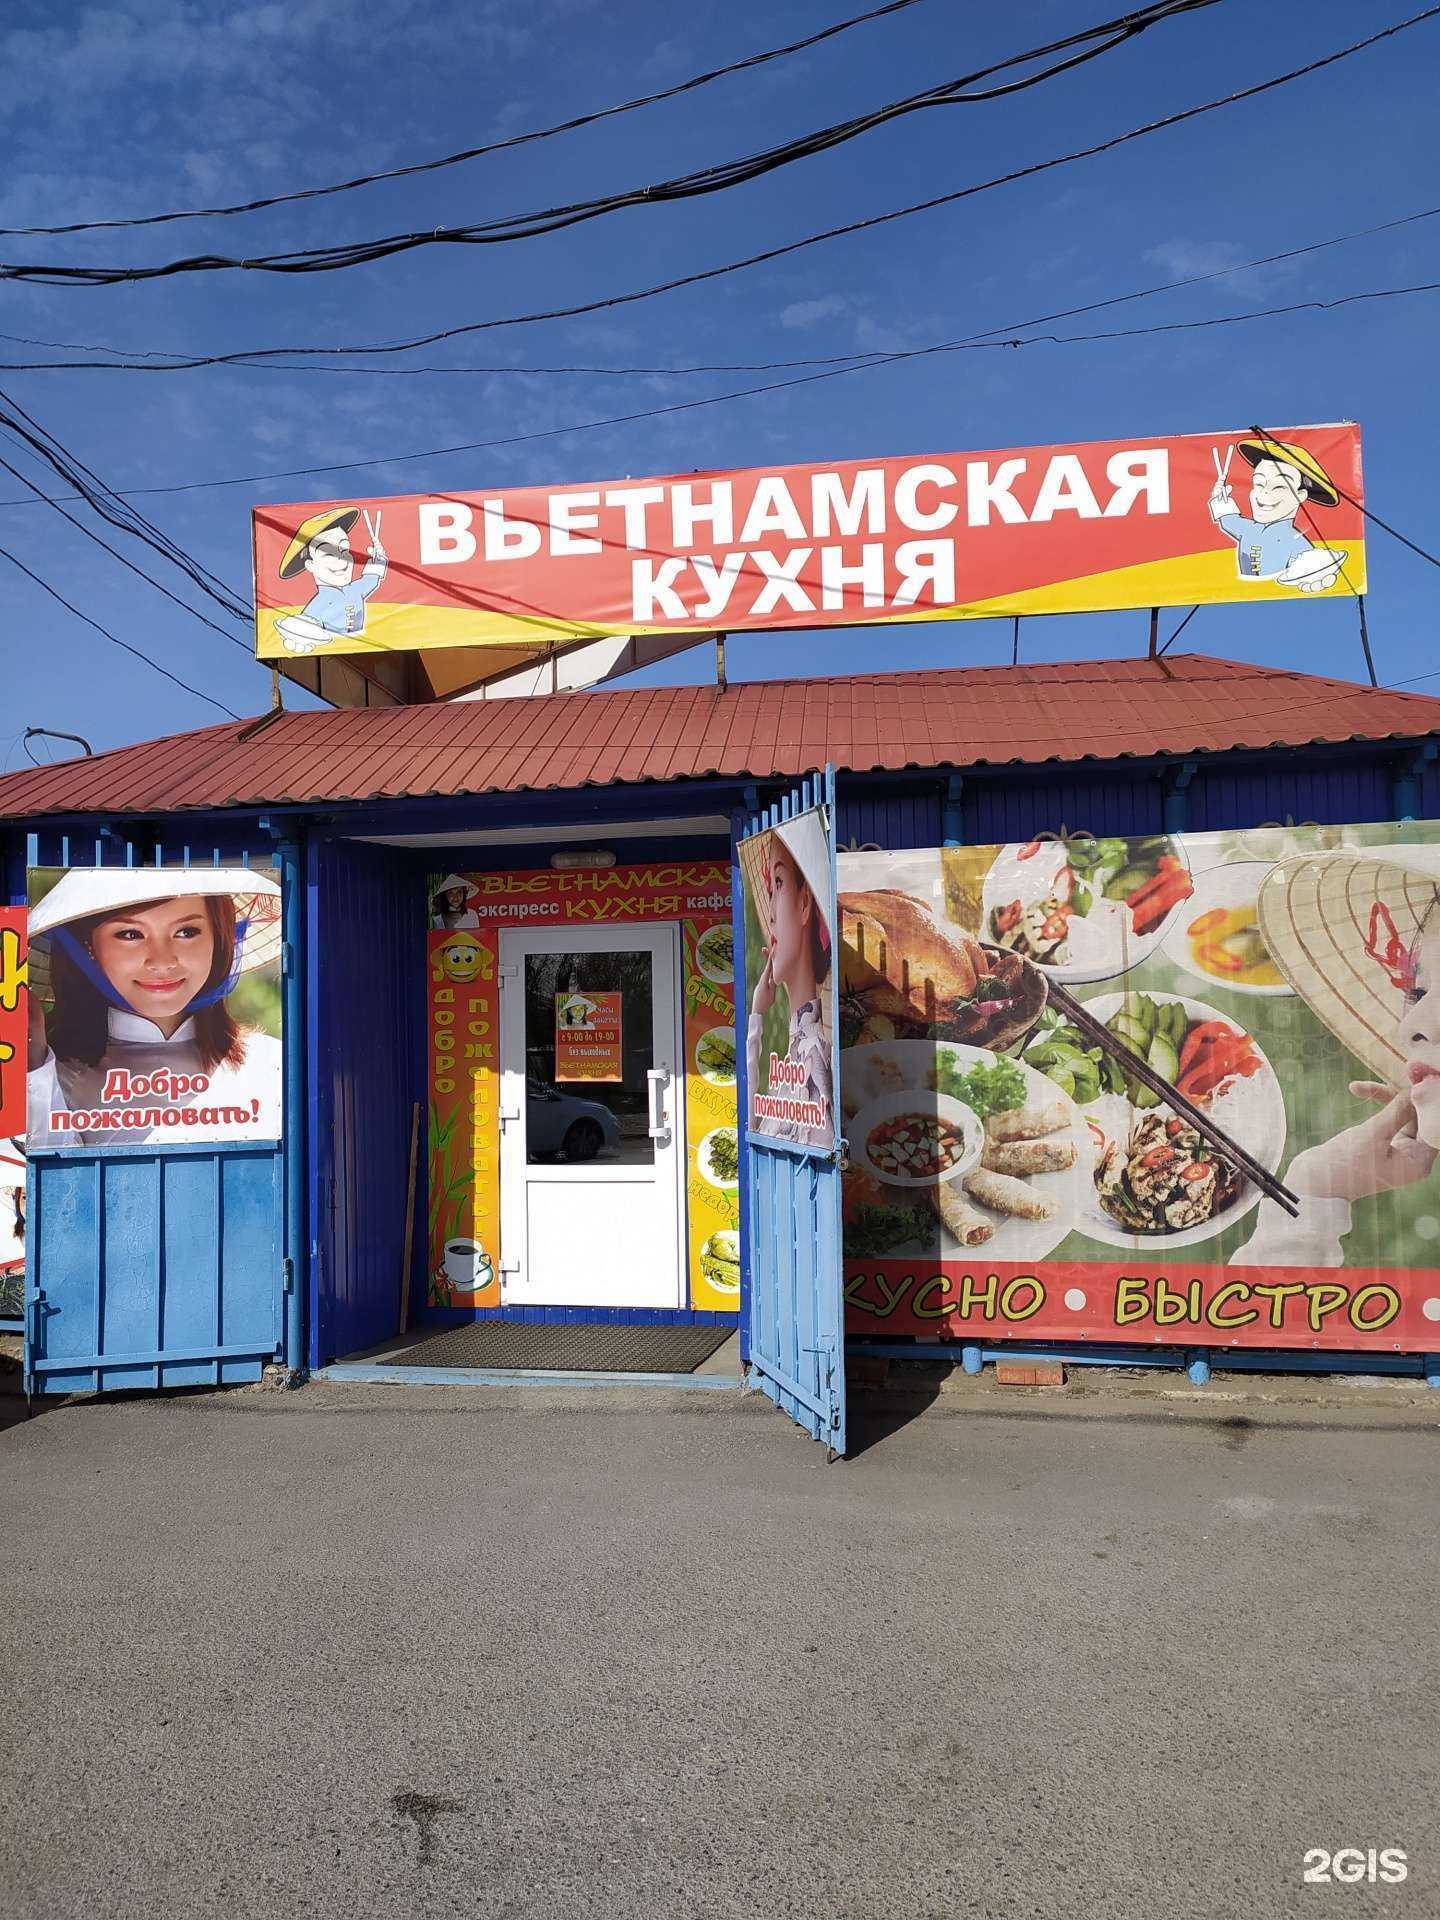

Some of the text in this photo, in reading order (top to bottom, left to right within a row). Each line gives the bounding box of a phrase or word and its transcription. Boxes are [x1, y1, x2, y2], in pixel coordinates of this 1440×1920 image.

[418, 447, 1170, 566] ВЬЕТНАМСКАЯ
[631, 537, 956, 622] КУХНЯ
[478, 891, 733, 920] экспресс КУХНЯ кафе
[567, 1031, 583, 1042] 9-00
[594, 1031, 615, 1041] 19-00
[103, 1069, 209, 1102] Добро
[769, 1053, 805, 1092] Добро
[51, 1099, 259, 1131] пожаловать!
[754, 1094, 826, 1128] пожаловать!
[1113, 1276, 1402, 1332] БЫСТРО
